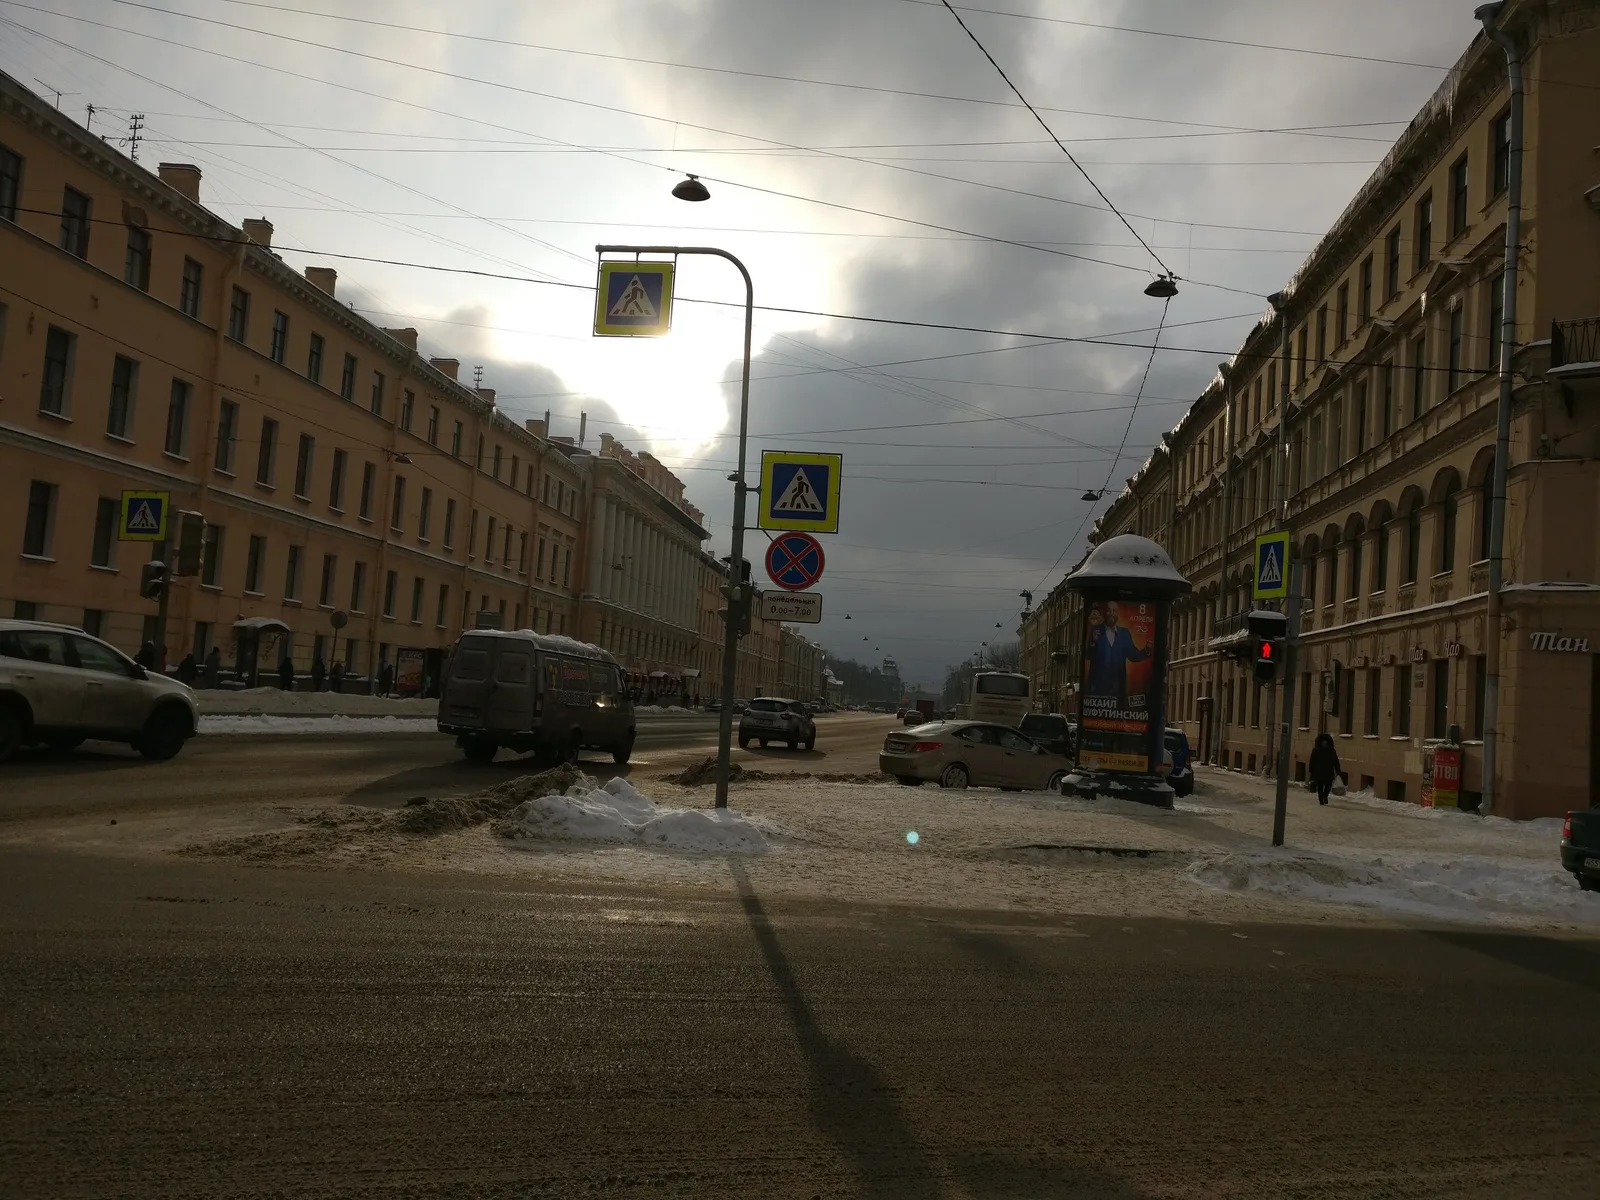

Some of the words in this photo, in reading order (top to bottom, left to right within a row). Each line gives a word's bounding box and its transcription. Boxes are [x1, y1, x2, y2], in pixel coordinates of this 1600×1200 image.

[767, 595, 817, 605] понедельник
[1139, 603, 1146, 614] 8
[1129, 615, 1153, 623] АПРЕЛЯ
[1529, 631, 1590, 653] Тан
[1083, 698, 1117, 709] МИХАИЛ
[1083, 708, 1149, 721] ШУФУТИНСКИЙ
